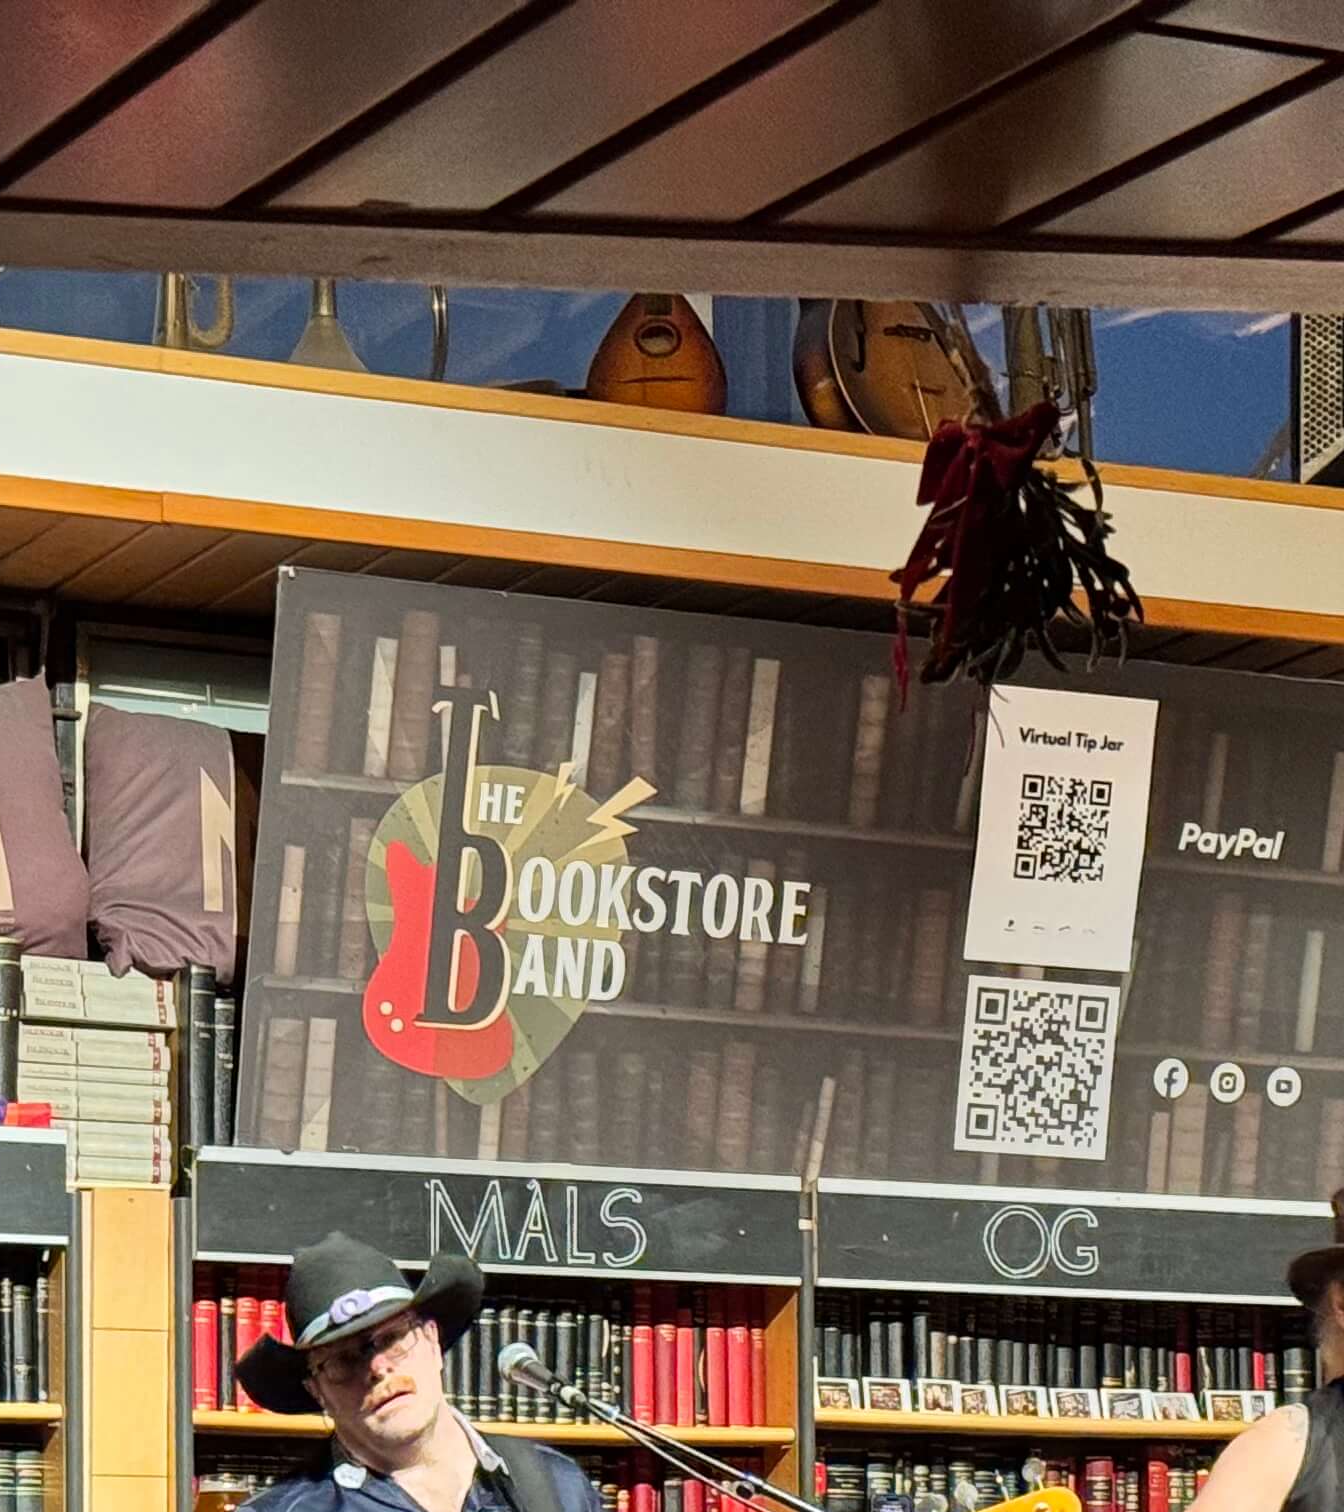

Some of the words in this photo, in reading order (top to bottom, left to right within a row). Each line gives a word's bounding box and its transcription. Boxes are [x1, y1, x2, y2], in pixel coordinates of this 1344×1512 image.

[1019, 726, 1072, 747] Virtual
[1075, 732, 1097, 753] Tip
[1100, 734, 1124, 752] Jar
[1178, 822, 1285, 860] PayPal
[982, 1203, 1100, 1279] OG
